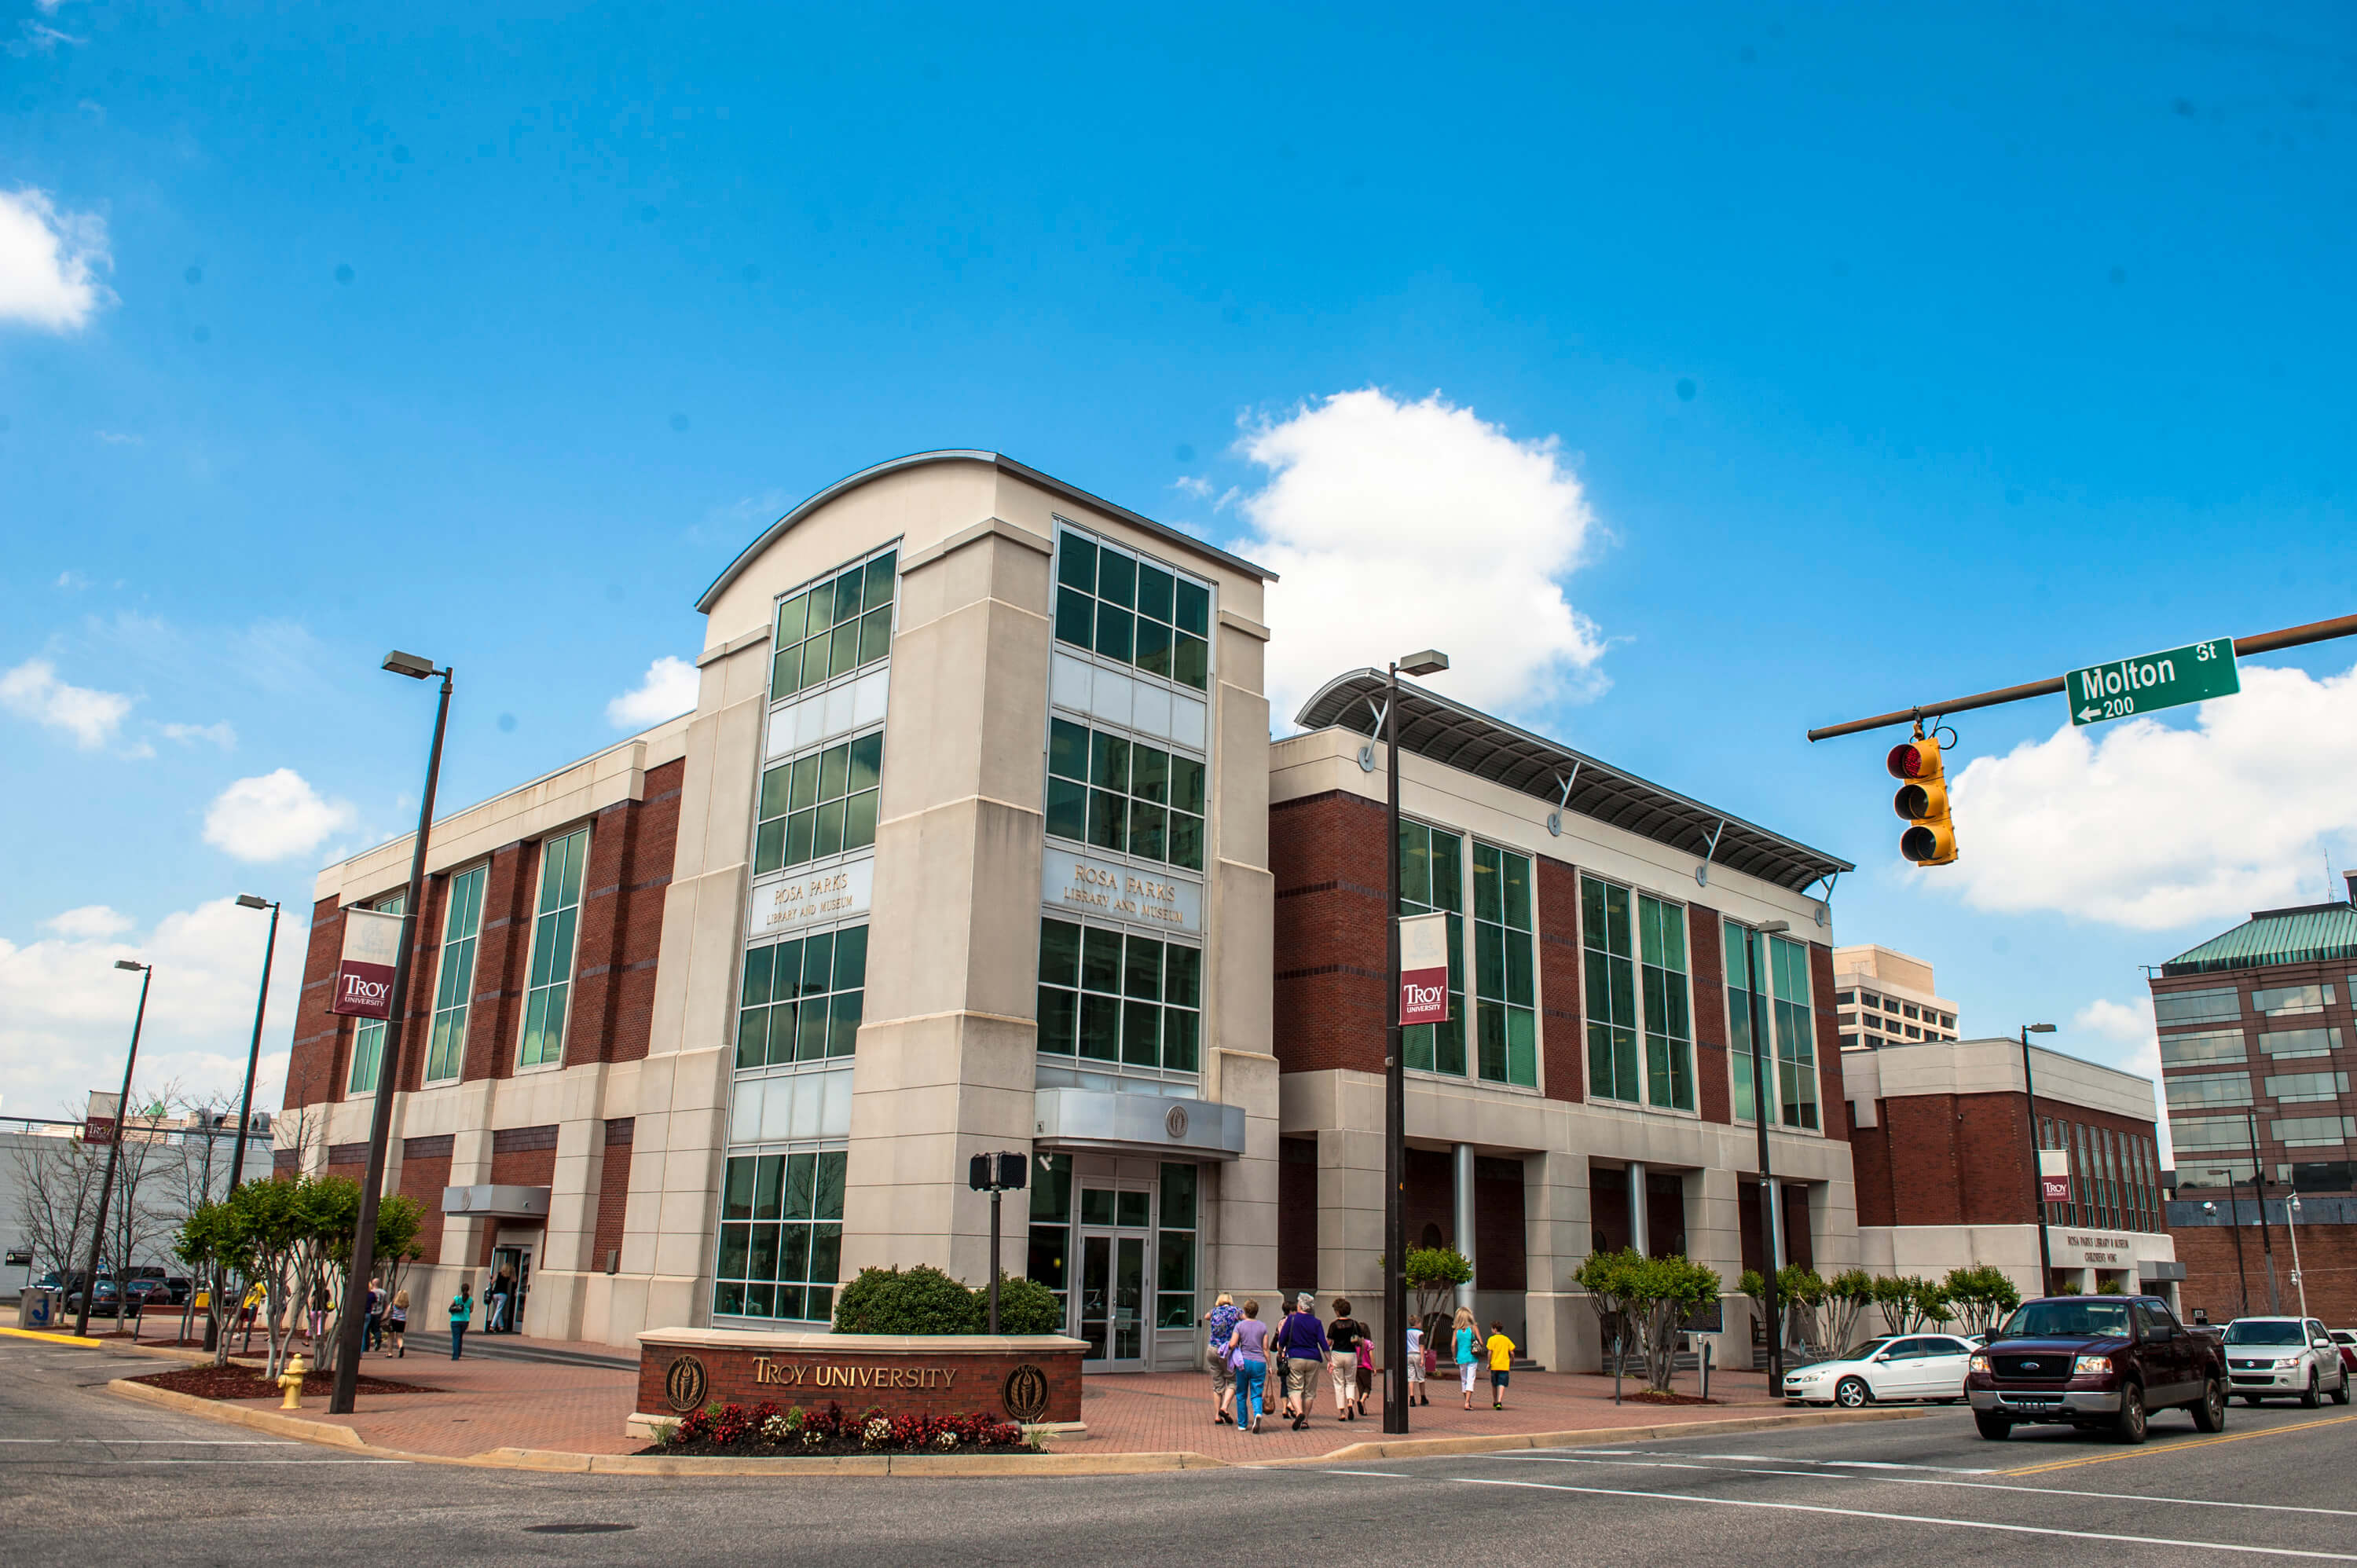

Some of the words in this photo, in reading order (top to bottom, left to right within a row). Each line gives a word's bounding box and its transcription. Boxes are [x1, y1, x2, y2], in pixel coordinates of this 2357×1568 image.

[2081, 659, 2176, 701] Molton
[2196, 642, 2217, 661] St
[2103, 696, 2135, 719] 200
[774, 885, 804, 905] ROSA
[809, 873, 849, 897] PARKS
[1074, 863, 1118, 889] ROSA
[1127, 876, 1175, 902] PARKS
[766, 908, 797, 925] LIBRARY
[800, 904, 816, 918] AND
[820, 895, 853, 913] MUSEUM
[1064, 886, 1109, 907] LIBRARY
[1114, 898, 1137, 913] AND
[1142, 904, 1183, 924] MUSEUM
[343, 973, 390, 998] TROY
[1403, 984, 1444, 1005] TROY
[344, 996, 385, 1006] UNIVERSITY
[1406, 1004, 1441, 1013] UNIVERSITY
[2044, 1181, 2067, 1192] TROY
[753, 1357, 809, 1386] TROY
[816, 1365, 958, 1388] UNIVERSITY
